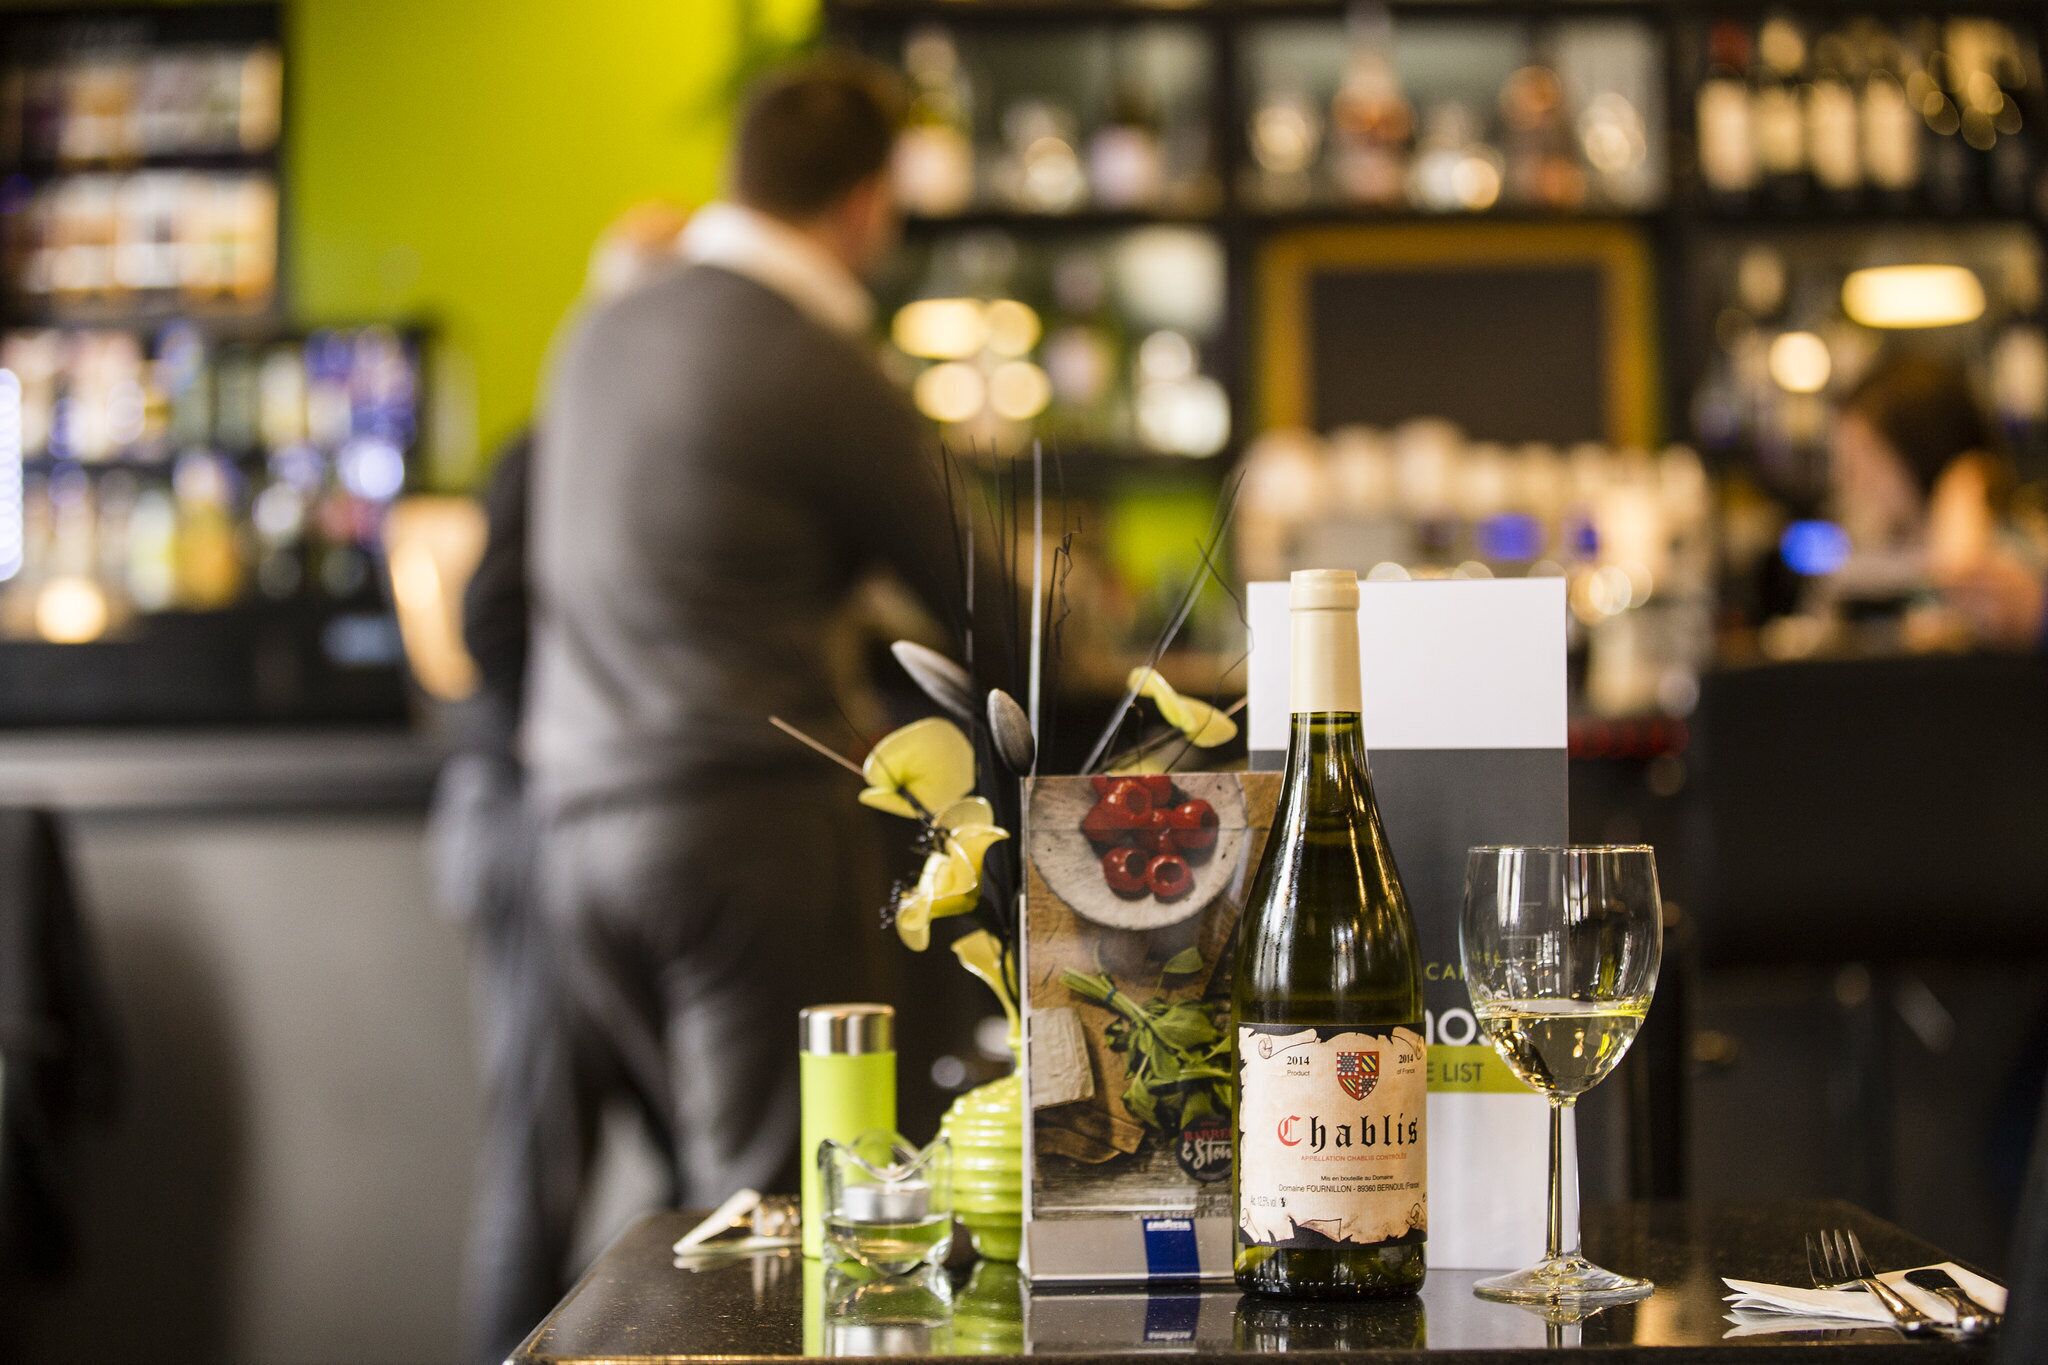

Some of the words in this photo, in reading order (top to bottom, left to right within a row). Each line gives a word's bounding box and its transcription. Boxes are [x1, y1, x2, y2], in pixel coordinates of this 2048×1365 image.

[1287, 1055, 1310, 1065] 2014
[1398, 1053, 1414, 1064] 2014
[1287, 1069, 1310, 1077] Product
[1443, 1062, 1485, 1083] LIST
[1277, 1113, 1418, 1154] Chablis
[1278, 1183, 1305, 1192] Domaine
[1306, 1185, 1352, 1193] FOURNILLON
[1356, 1184, 1376, 1192] 89360
